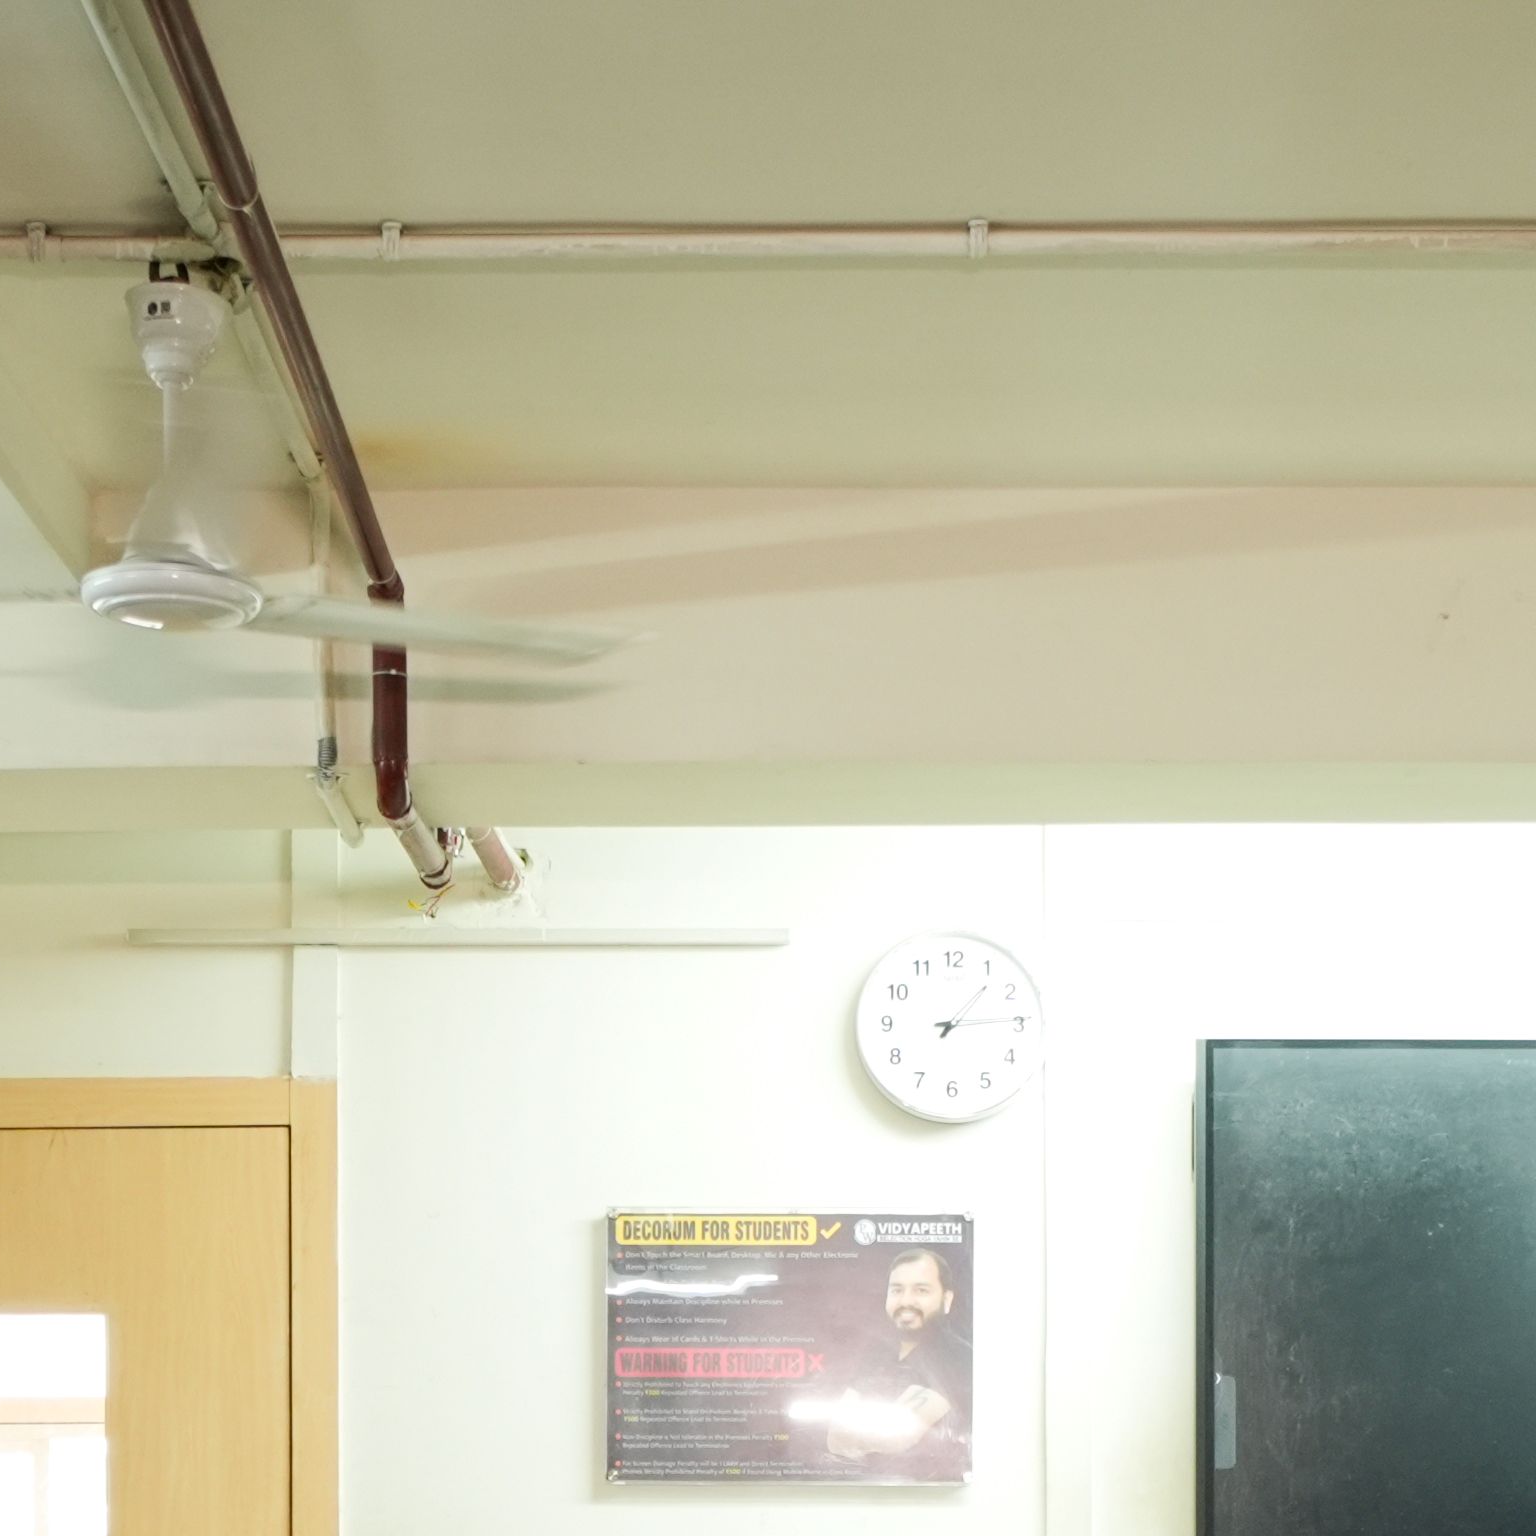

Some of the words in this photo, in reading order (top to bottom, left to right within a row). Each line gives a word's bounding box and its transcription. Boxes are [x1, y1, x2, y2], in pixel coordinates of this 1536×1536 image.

[913, 960, 930, 976] 11
[943, 951, 964, 968] 12
[984, 960, 991, 976] 1
[887, 984, 909, 1001] 10
[1004, 983, 1016, 1000] 2
[881, 1015, 893, 1032] 9
[1013, 1016, 1025, 1032] 3
[889, 1048, 901, 1065] 8
[1004, 1048, 1016, 1065] 4
[914, 1072, 926, 1088] 7
[980, 1072, 991, 1089] 5
[946, 1081, 958, 1098] 6
[623, 1220, 696, 1240] DECORUM
[701, 1220, 730, 1240] FOR
[735, 1220, 810, 1240] STUDENTS
[877, 1222, 962, 1235] VIDYAPEETH
[621, 1352, 688, 1373] WARNING
[693, 1352, 721, 1373] FOR
[726, 1352, 800, 1374] STUDENTS
